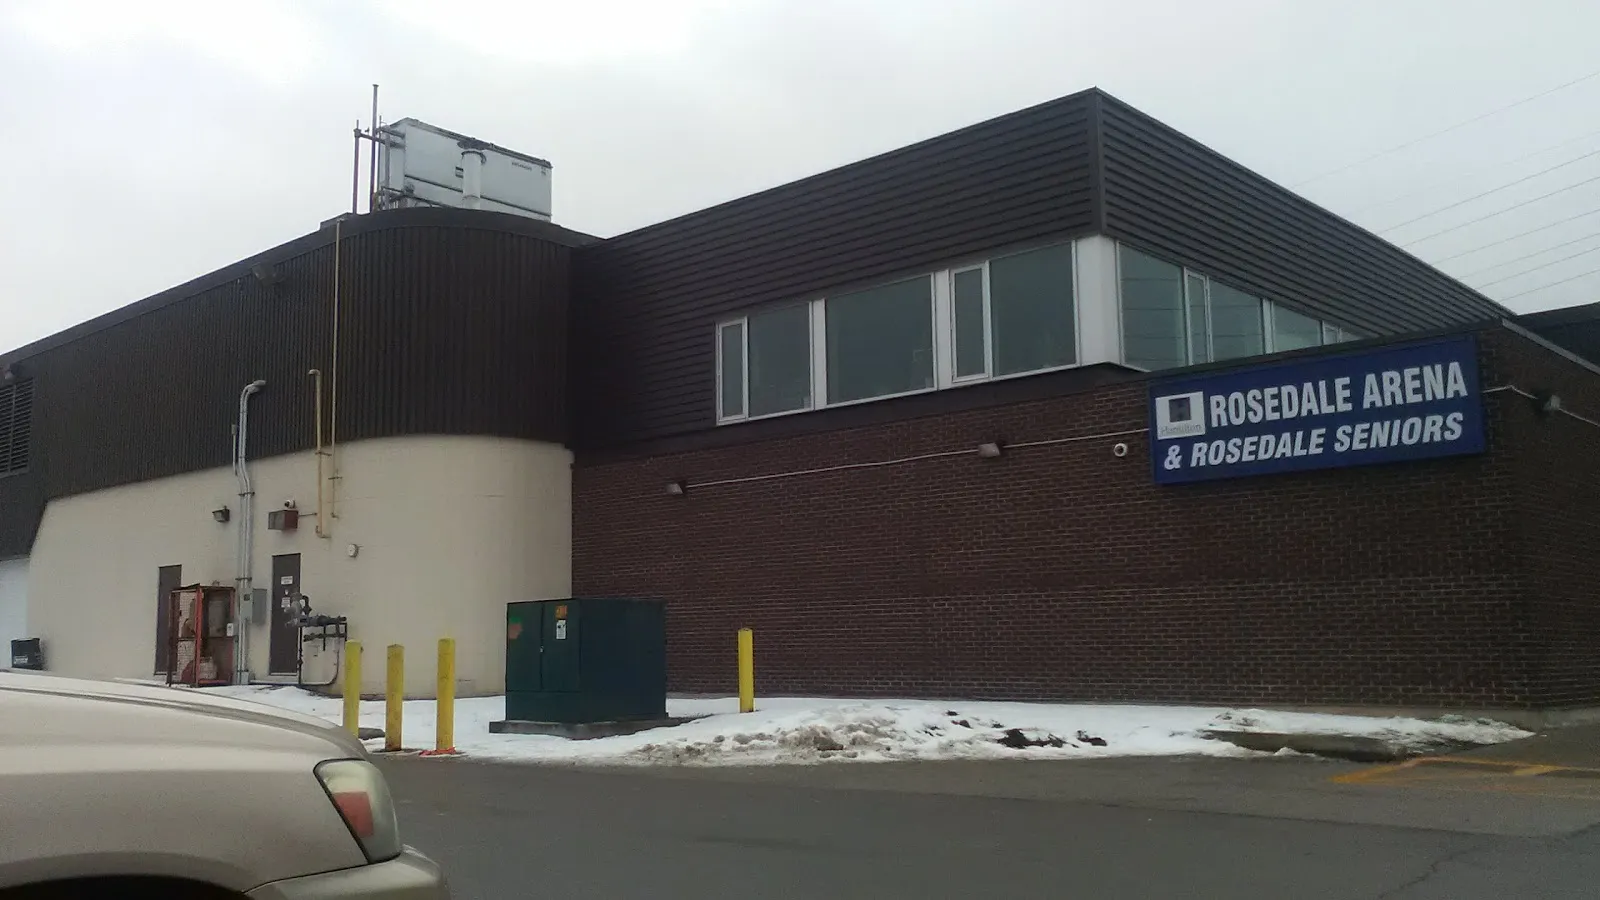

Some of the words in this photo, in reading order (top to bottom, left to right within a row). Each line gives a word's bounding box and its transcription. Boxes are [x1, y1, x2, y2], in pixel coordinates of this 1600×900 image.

[1209, 376, 1352, 427] ROSEDALE
[1362, 361, 1468, 409] ARENA
[1164, 445, 1182, 470] &
[1190, 428, 1326, 467] ROSEDALE
[1334, 412, 1464, 452] SENIORS
